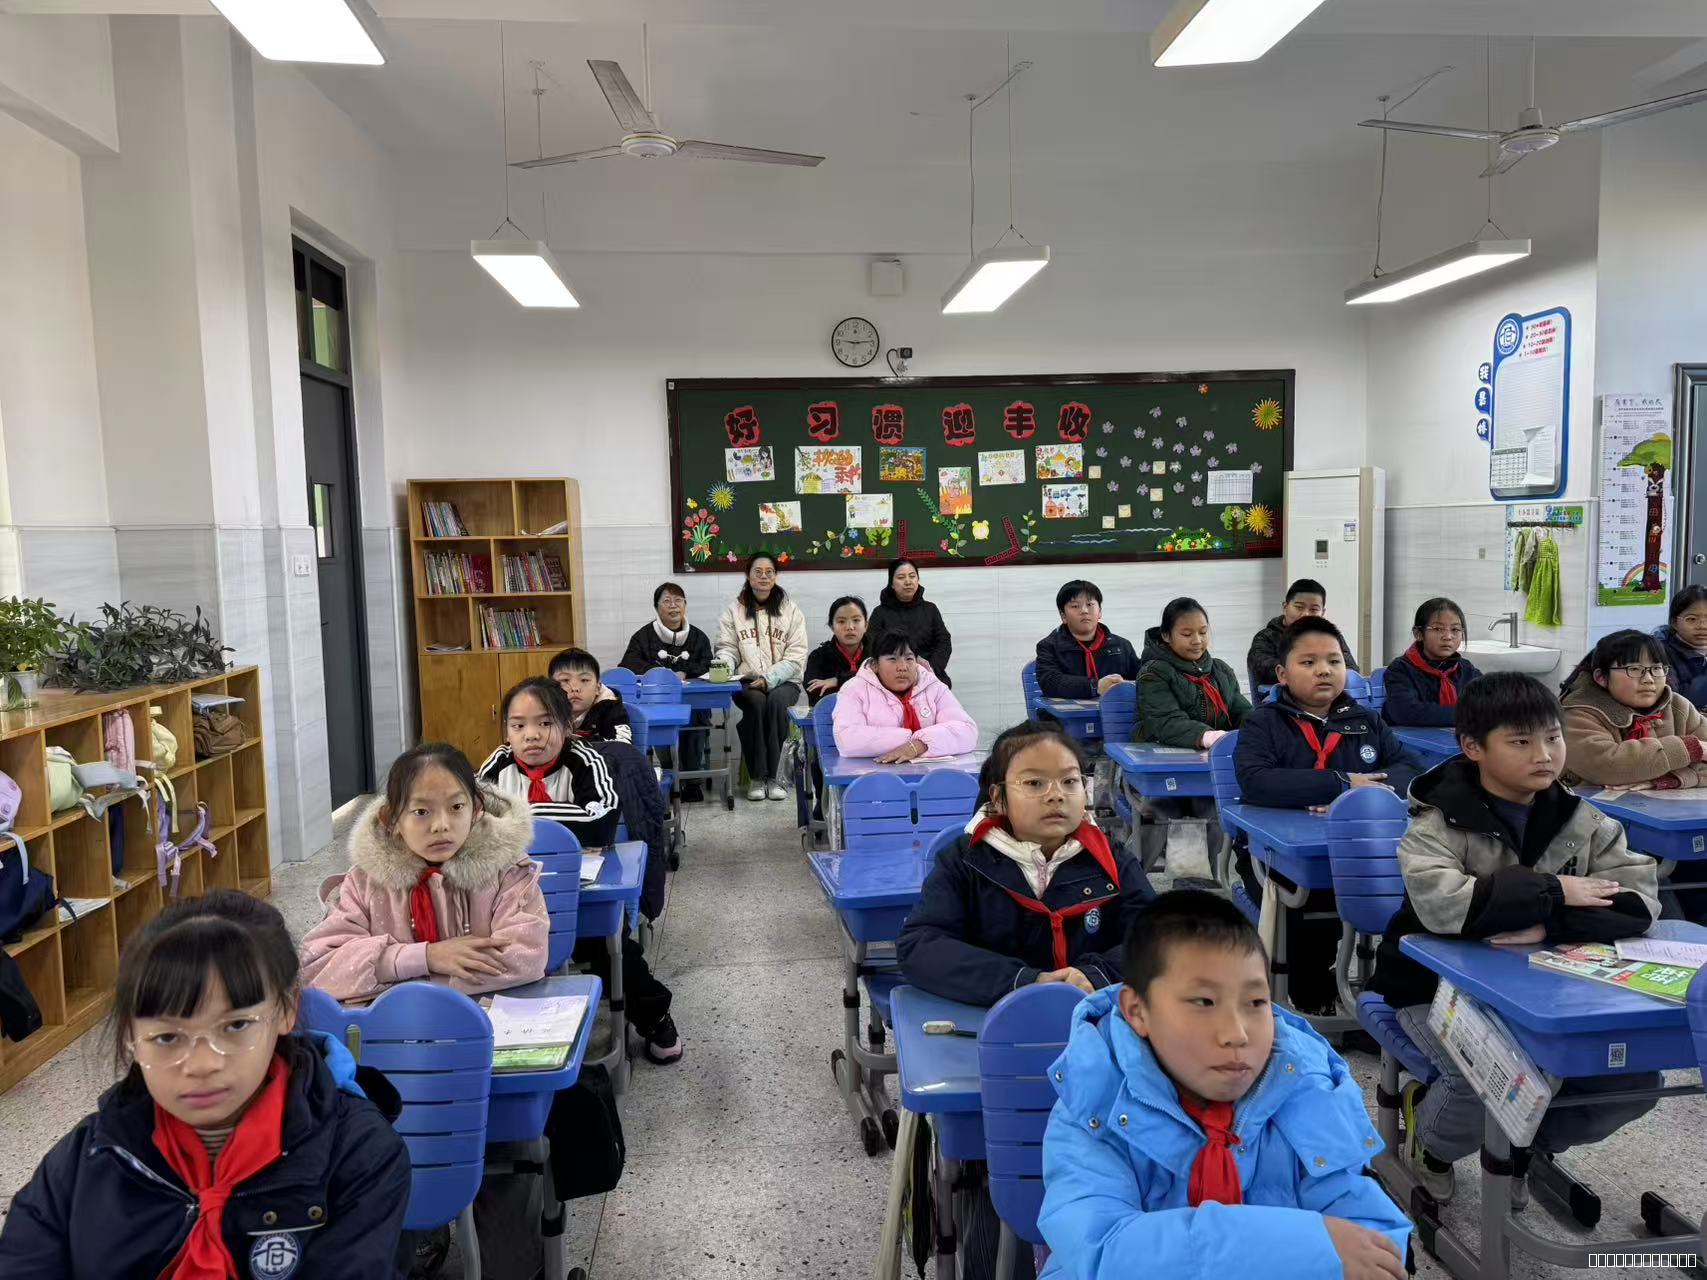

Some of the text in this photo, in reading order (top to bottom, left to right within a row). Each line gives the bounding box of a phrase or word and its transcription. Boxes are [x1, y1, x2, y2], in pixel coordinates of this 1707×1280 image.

[726, 401, 1090, 447] 好习惯迎丰收
[738, 626, 789, 644] REAMS
